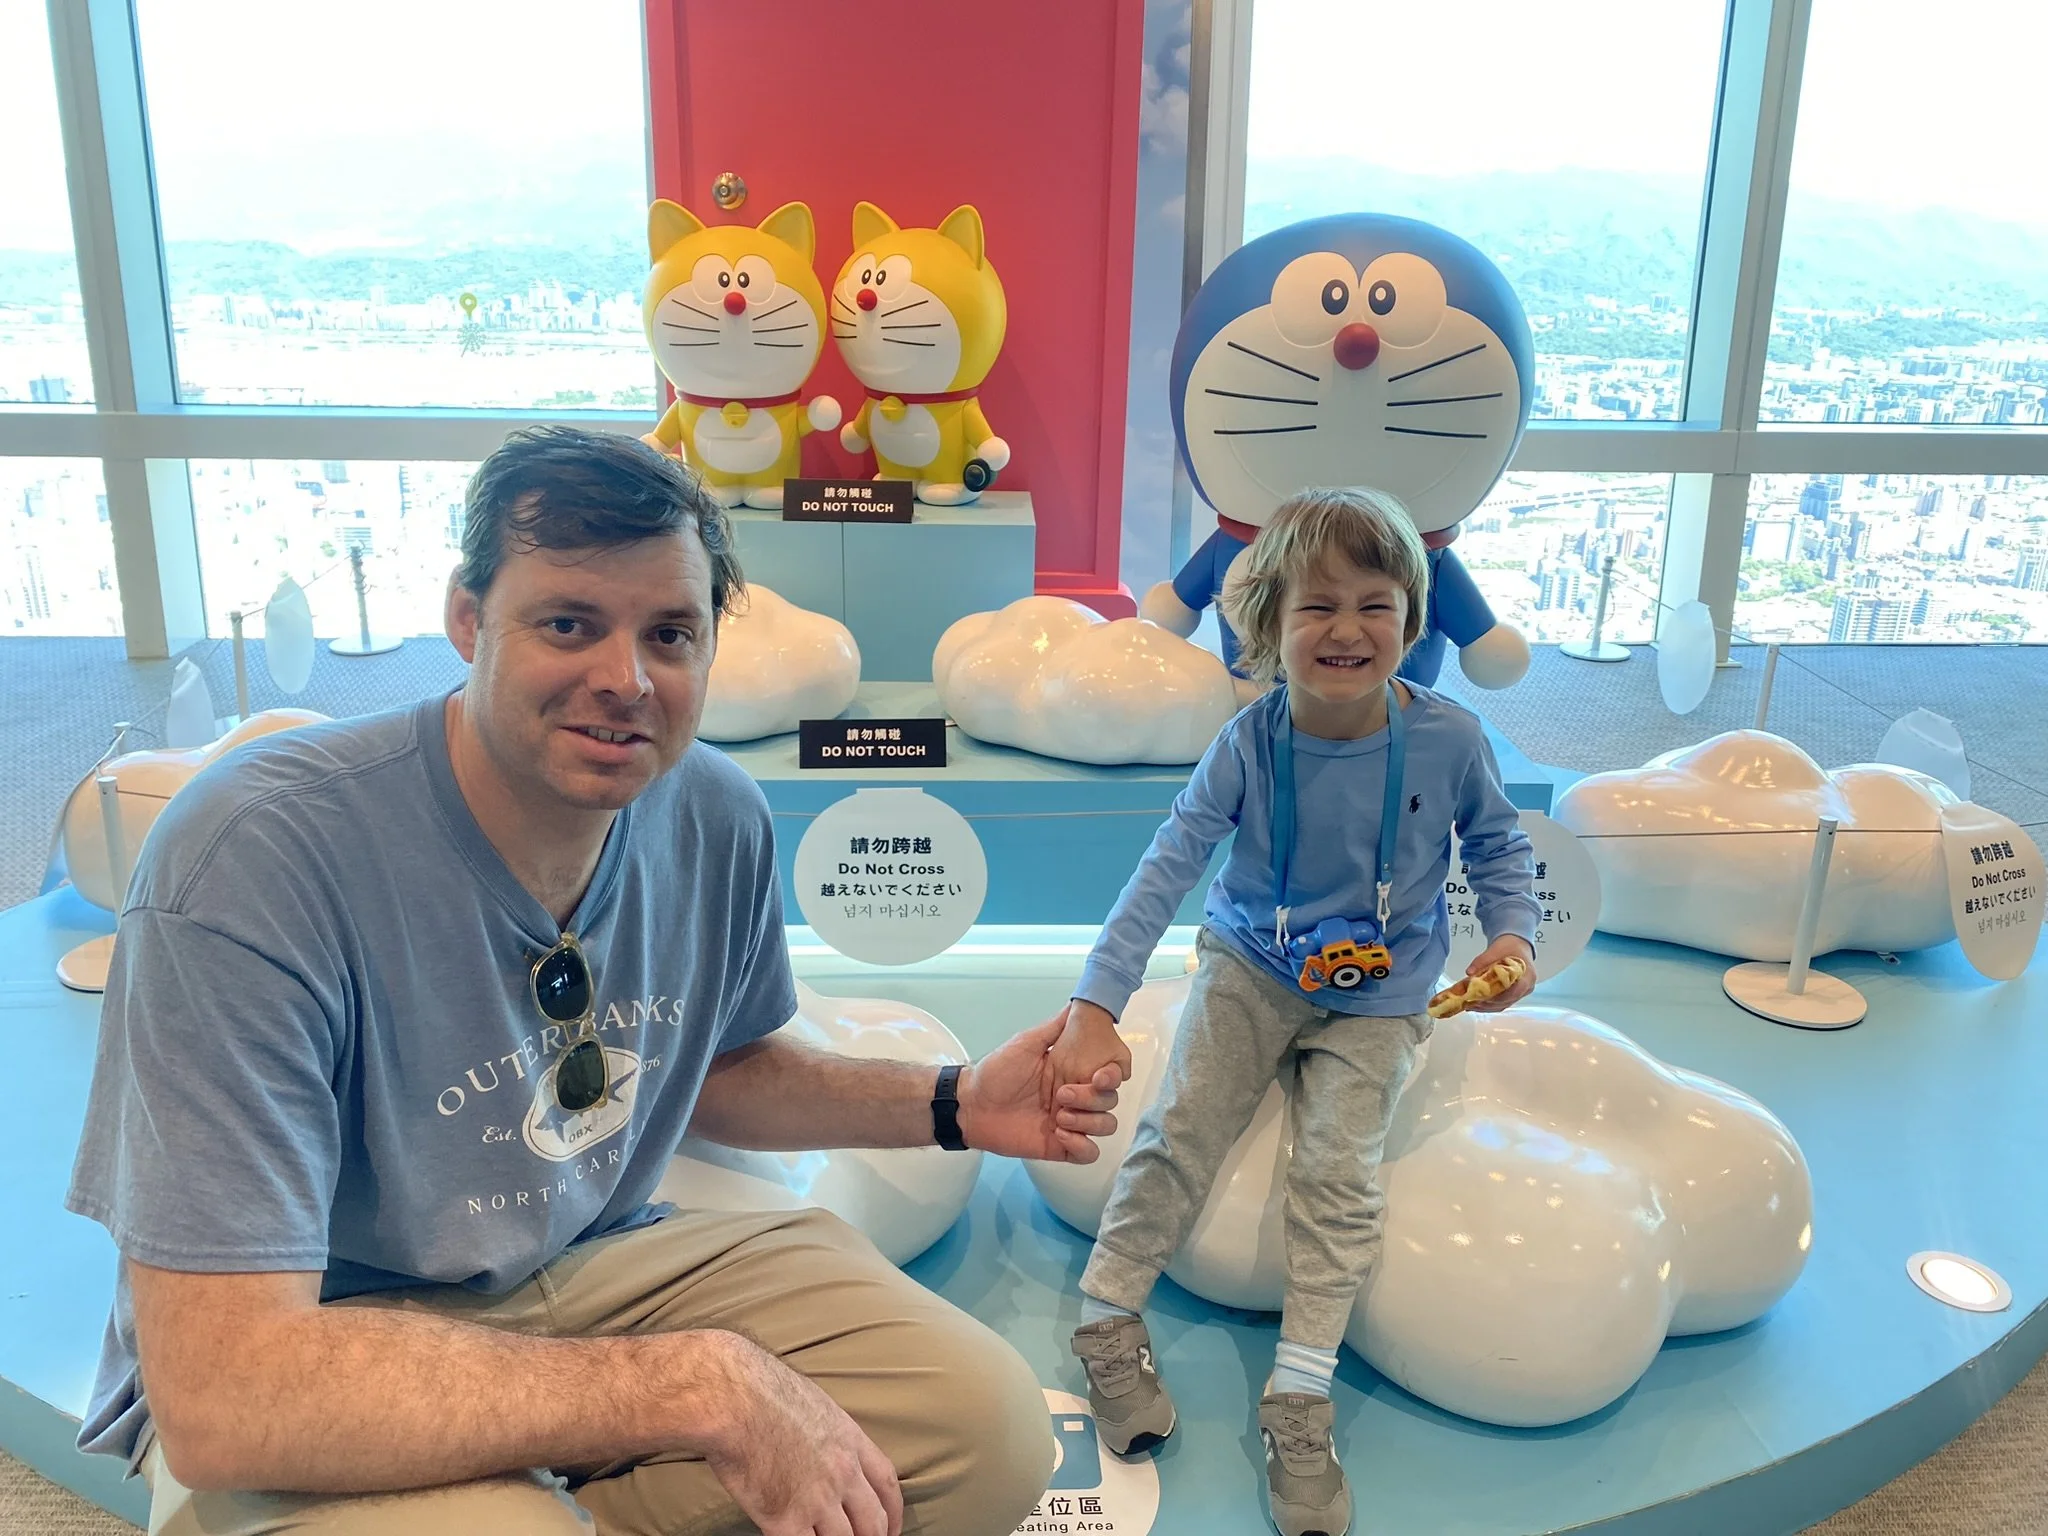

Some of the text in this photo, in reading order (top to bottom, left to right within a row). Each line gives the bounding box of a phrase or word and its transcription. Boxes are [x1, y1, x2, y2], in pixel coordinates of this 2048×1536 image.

[824, 487, 873, 499] 請勿觸碰
[802, 501, 894, 513] DO NOT TOUCH
[846, 728, 901, 741] 請勿觸碰
[822, 745, 926, 757] DO NOT TOUCH
[850, 837, 932, 855] 請勿跨越
[1970, 840, 2015, 865] 請勿跨越
[838, 863, 945, 875] Do Not Cross
[1971, 868, 2026, 888] Do Not Cross
[821, 883, 962, 897] 越えないでください
[1445, 882, 1468, 894] Do
[1965, 886, 2036, 914] 越えないでください
[844, 903, 942, 918] 넘지 마십시오
[1995, 910, 2027, 929] 마십시오
[437, 1025, 564, 1116] OUTER
[481, 1055, 662, 1144] Est. 876
[568, 1124, 594, 1144] OBX
[467, 1179, 567, 1215] NORTH
[1016, 1521, 1114, 1534] eating Area
